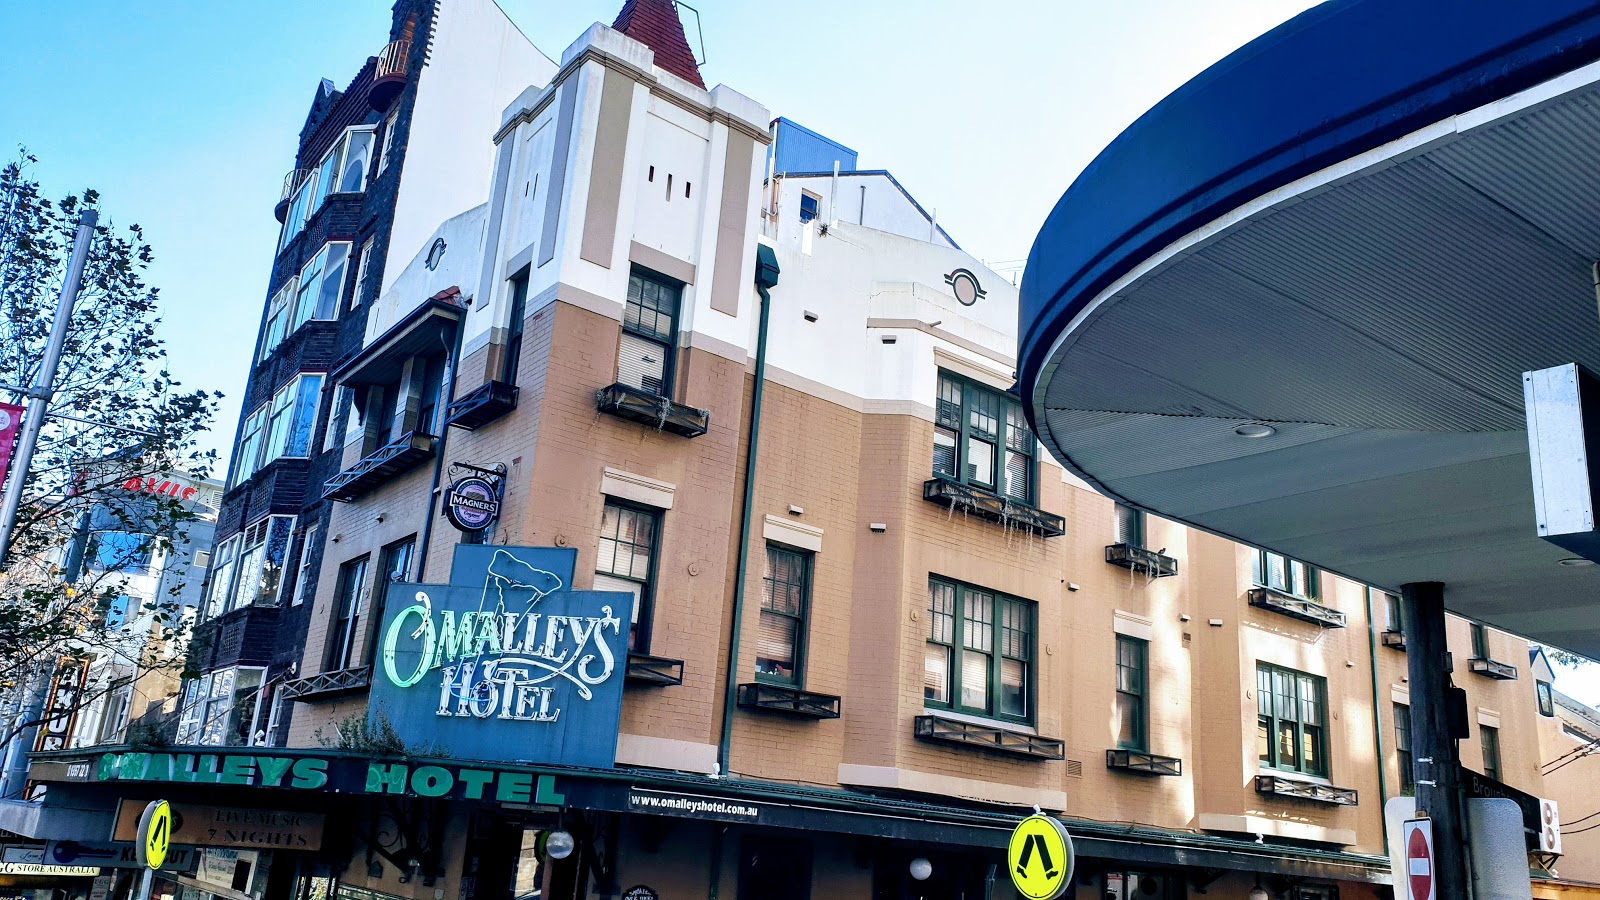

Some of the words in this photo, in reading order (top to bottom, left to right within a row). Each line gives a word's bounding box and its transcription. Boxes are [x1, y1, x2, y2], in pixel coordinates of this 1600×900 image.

[453, 495, 495, 512] MAGNERS
[436, 663, 560, 722] HOTEL
[365, 762, 565, 806] HOTEL
[631, 794, 758, 817] www.omalleyshotel.com.au
[215, 810, 252, 824] LIVE
[258, 813, 307, 828] MUSIC
[207, 827, 218, 842] 7
[224, 829, 308, 847] NIGHTS
[16, 864, 46, 873] STORE
[48, 866, 96, 875] AUSTRALIA
